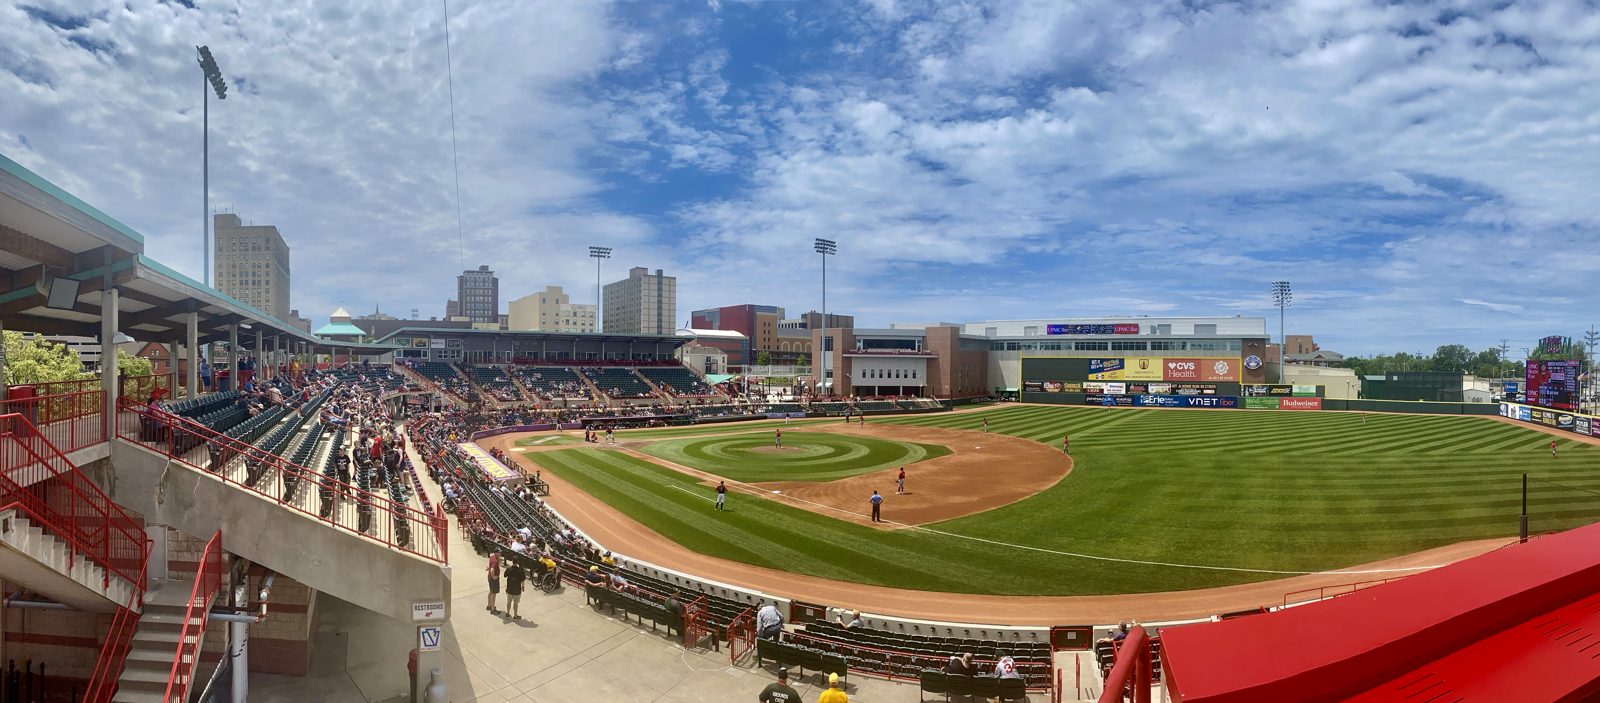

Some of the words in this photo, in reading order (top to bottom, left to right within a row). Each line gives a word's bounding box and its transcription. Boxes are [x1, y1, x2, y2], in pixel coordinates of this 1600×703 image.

[1176, 362, 1195, 370] CVS
[1149, 395, 1165, 404] Erie
[414, 603, 443, 611] RESTROOMS
